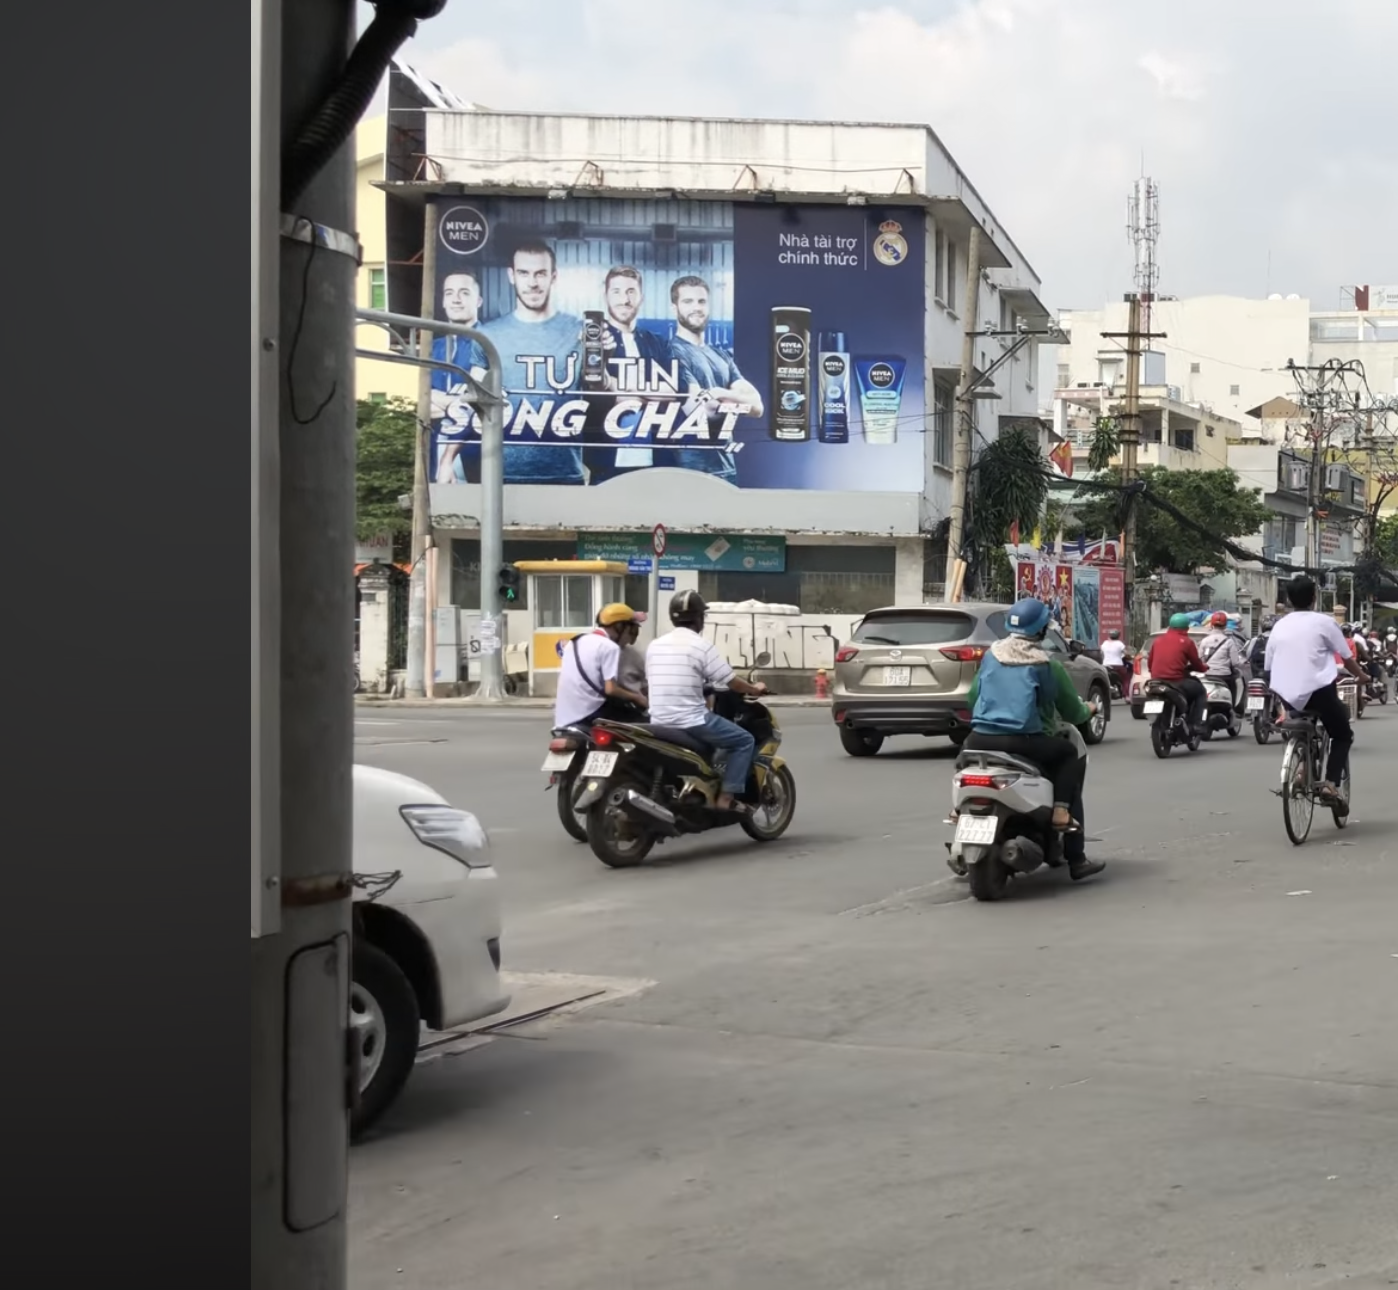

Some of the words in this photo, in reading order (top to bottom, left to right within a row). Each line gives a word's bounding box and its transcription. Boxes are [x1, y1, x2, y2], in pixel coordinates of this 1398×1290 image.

[445, 221, 482, 232] NIVEA
[449, 232, 480, 241] MEN
[778, 233, 810, 247] Nhà
[814, 235, 832, 248] tài
[836, 236, 858, 251] trợ
[778, 251, 819, 265] chính
[824, 252, 858, 266] thức
[515, 352, 579, 395] TỰ
[608, 355, 679, 392] TIN
